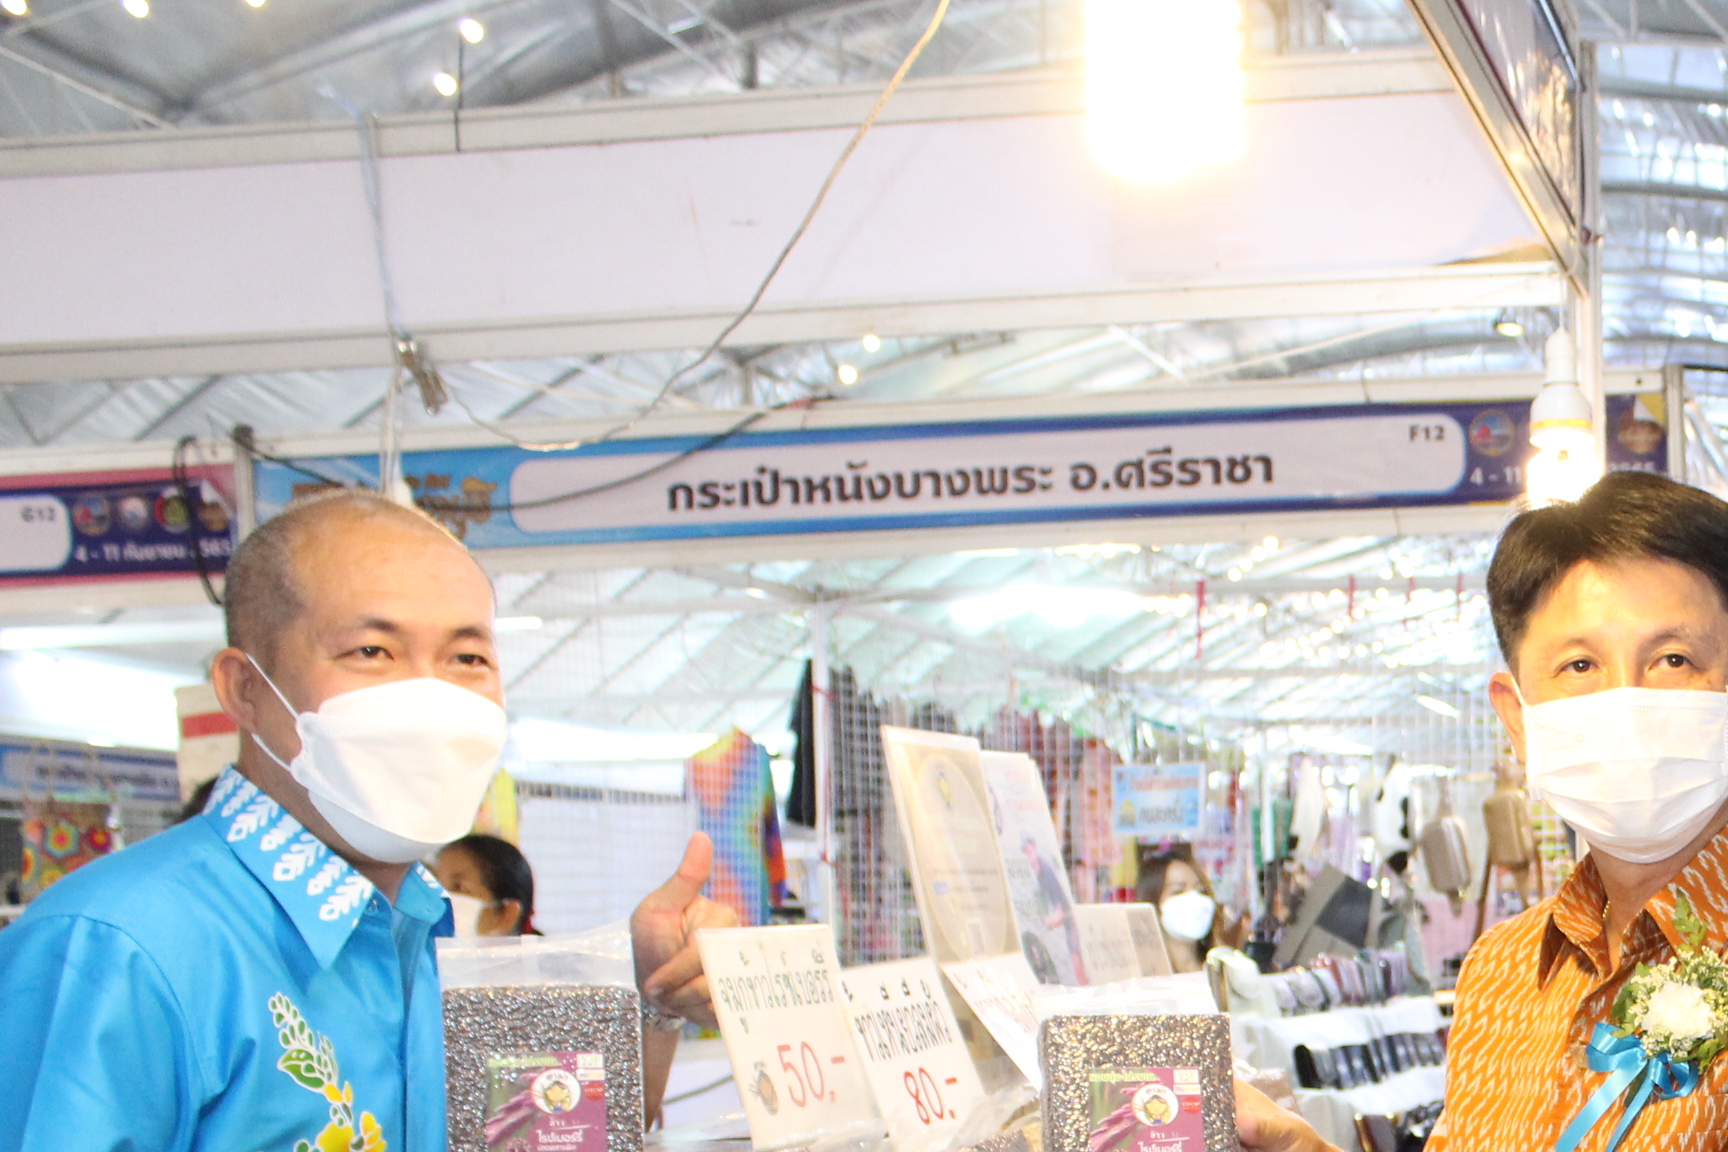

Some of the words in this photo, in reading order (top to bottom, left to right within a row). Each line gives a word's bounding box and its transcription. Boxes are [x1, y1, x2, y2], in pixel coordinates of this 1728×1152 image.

[1409, 425, 1445, 441] F12
[668, 460, 1053, 511] กระเป๋าหนังบางพระ
[1070, 446, 1274, 492] อ.ศรีราชา
[1470, 467, 1484, 485] 4
[777, 1041, 845, 1107] 50.-
[903, 1067, 957, 1125] 80.-
